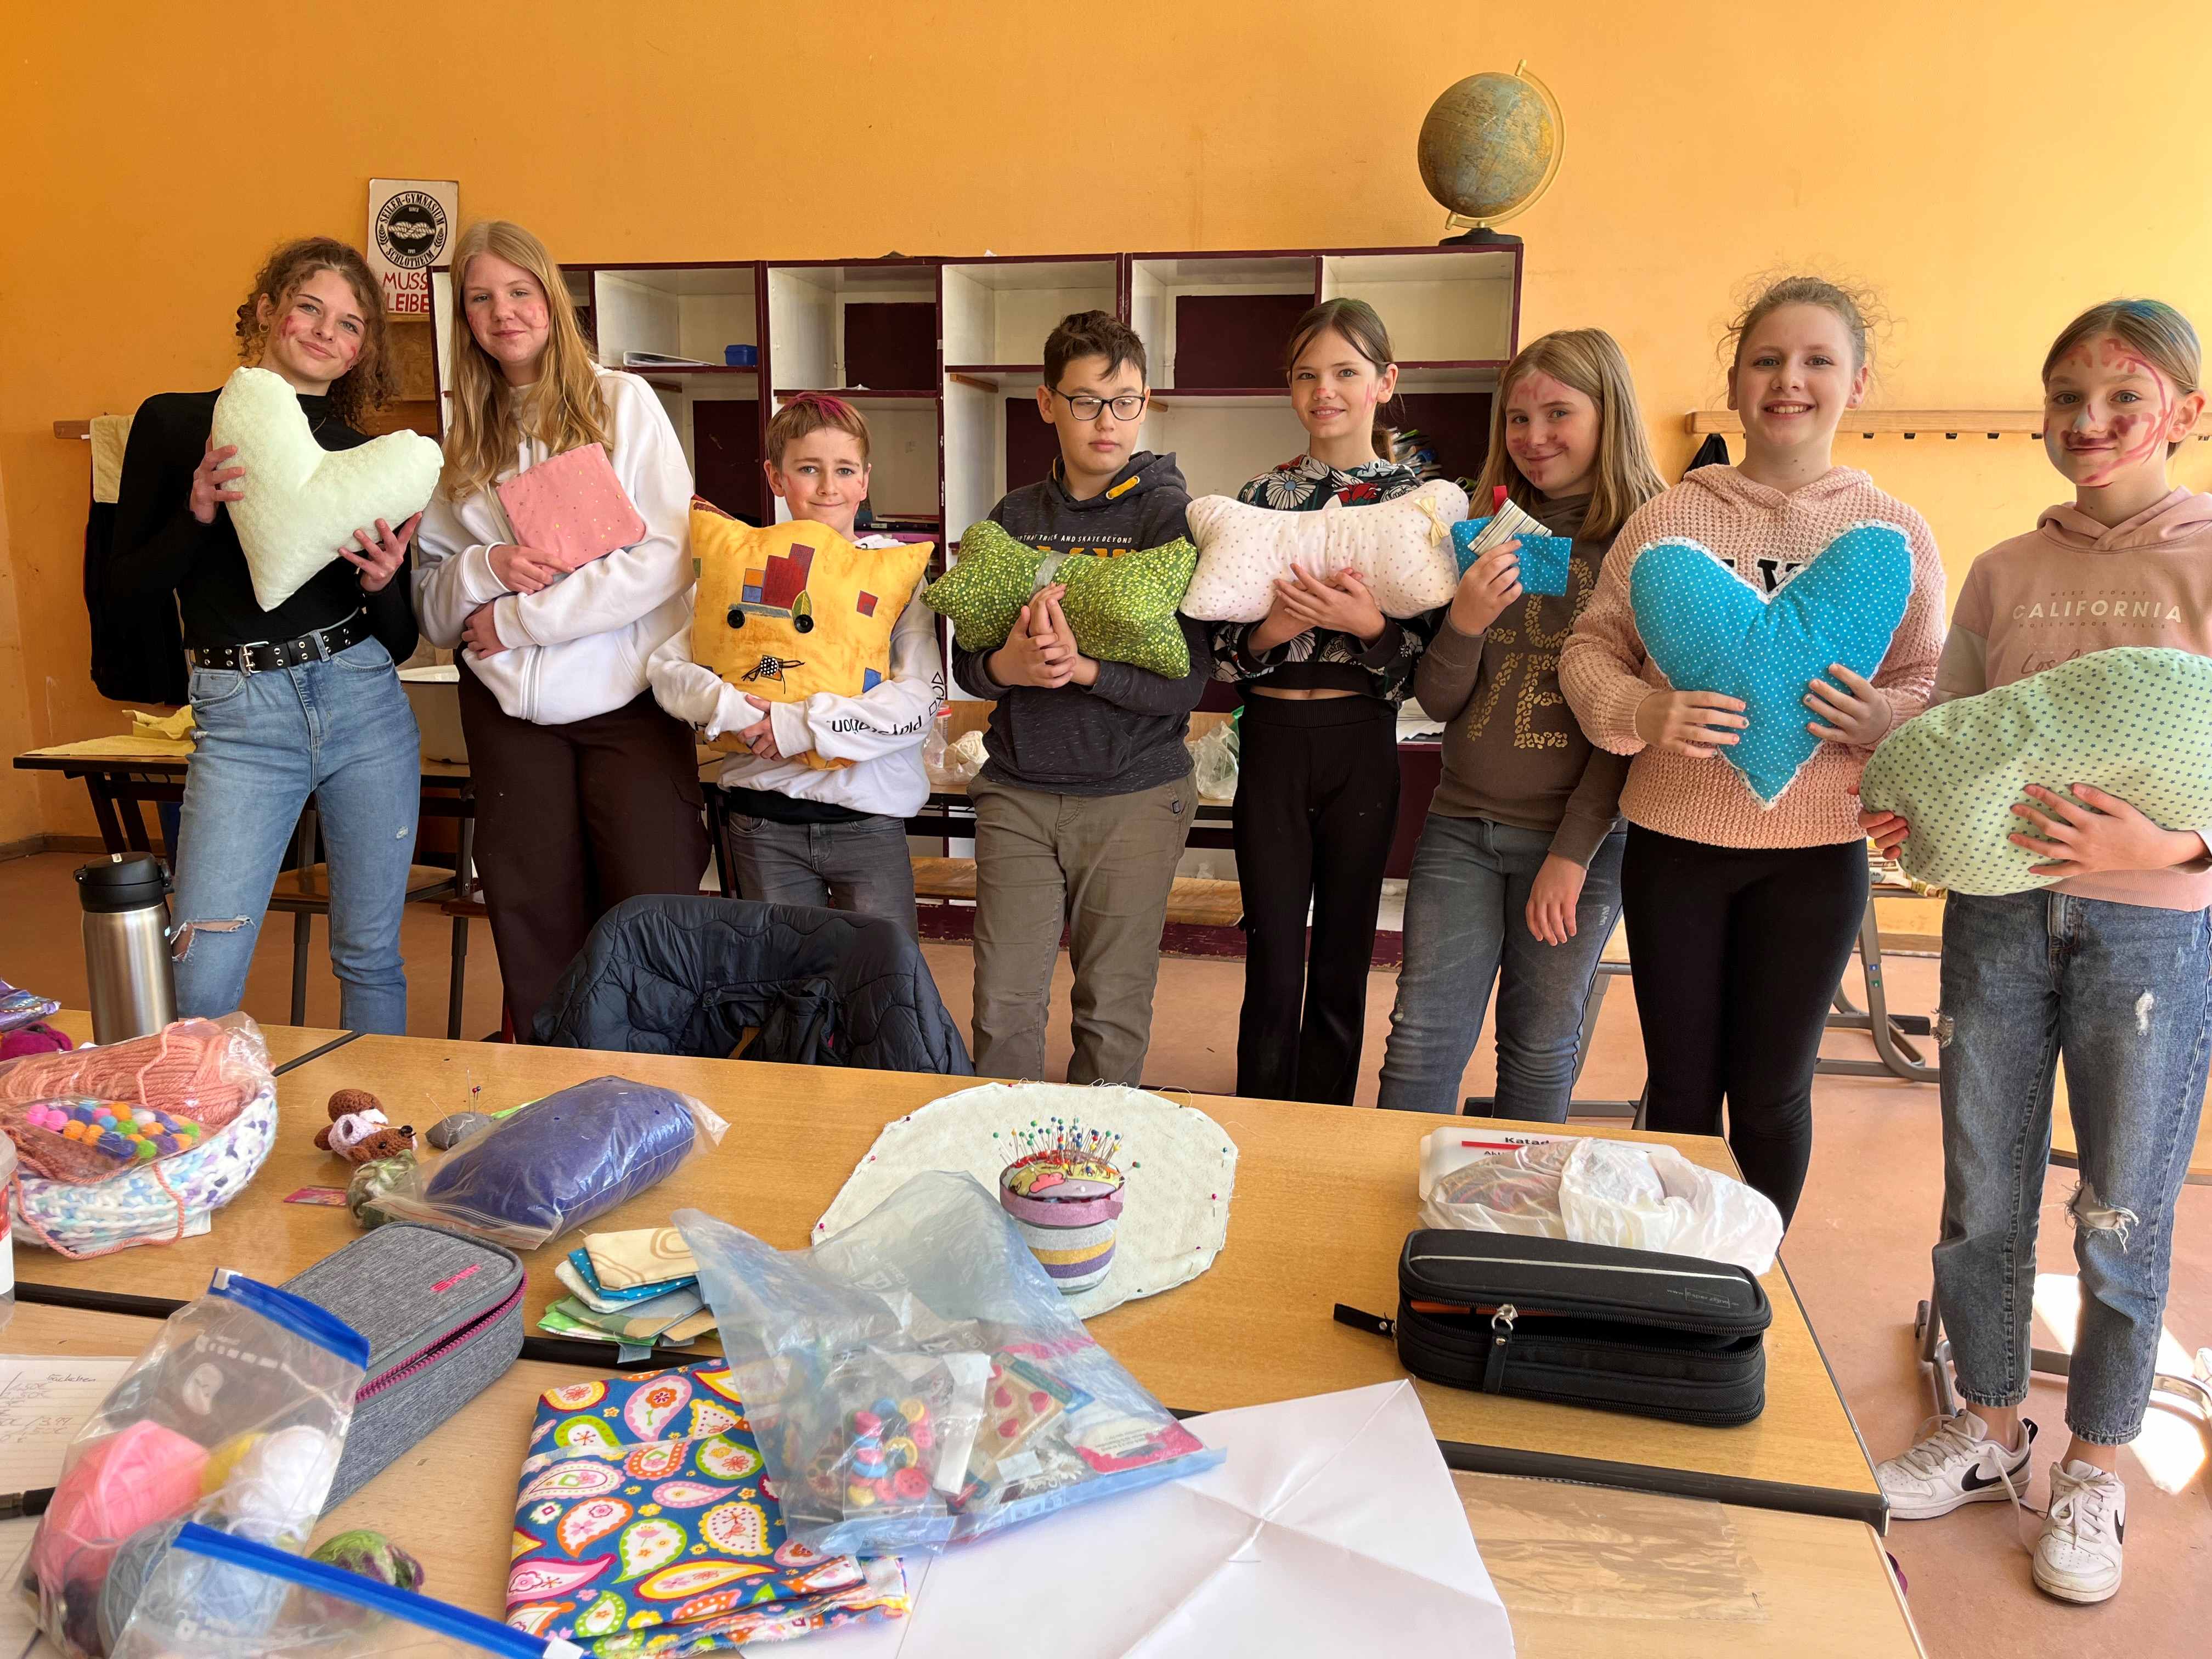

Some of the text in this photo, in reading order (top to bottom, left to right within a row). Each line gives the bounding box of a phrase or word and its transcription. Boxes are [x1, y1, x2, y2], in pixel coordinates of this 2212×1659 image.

[379, 193, 444, 225] SEILER-GYMNASIUM
[386, 247, 435, 267] SCHLOTHEIM
[382, 272, 428, 290] MUSS
[386, 292, 430, 313] LEIBE
[1060, 534, 1076, 543] AND
[1101, 535, 1133, 544] BEYOND
[2012, 599, 2182, 623] CALIFORNIA
